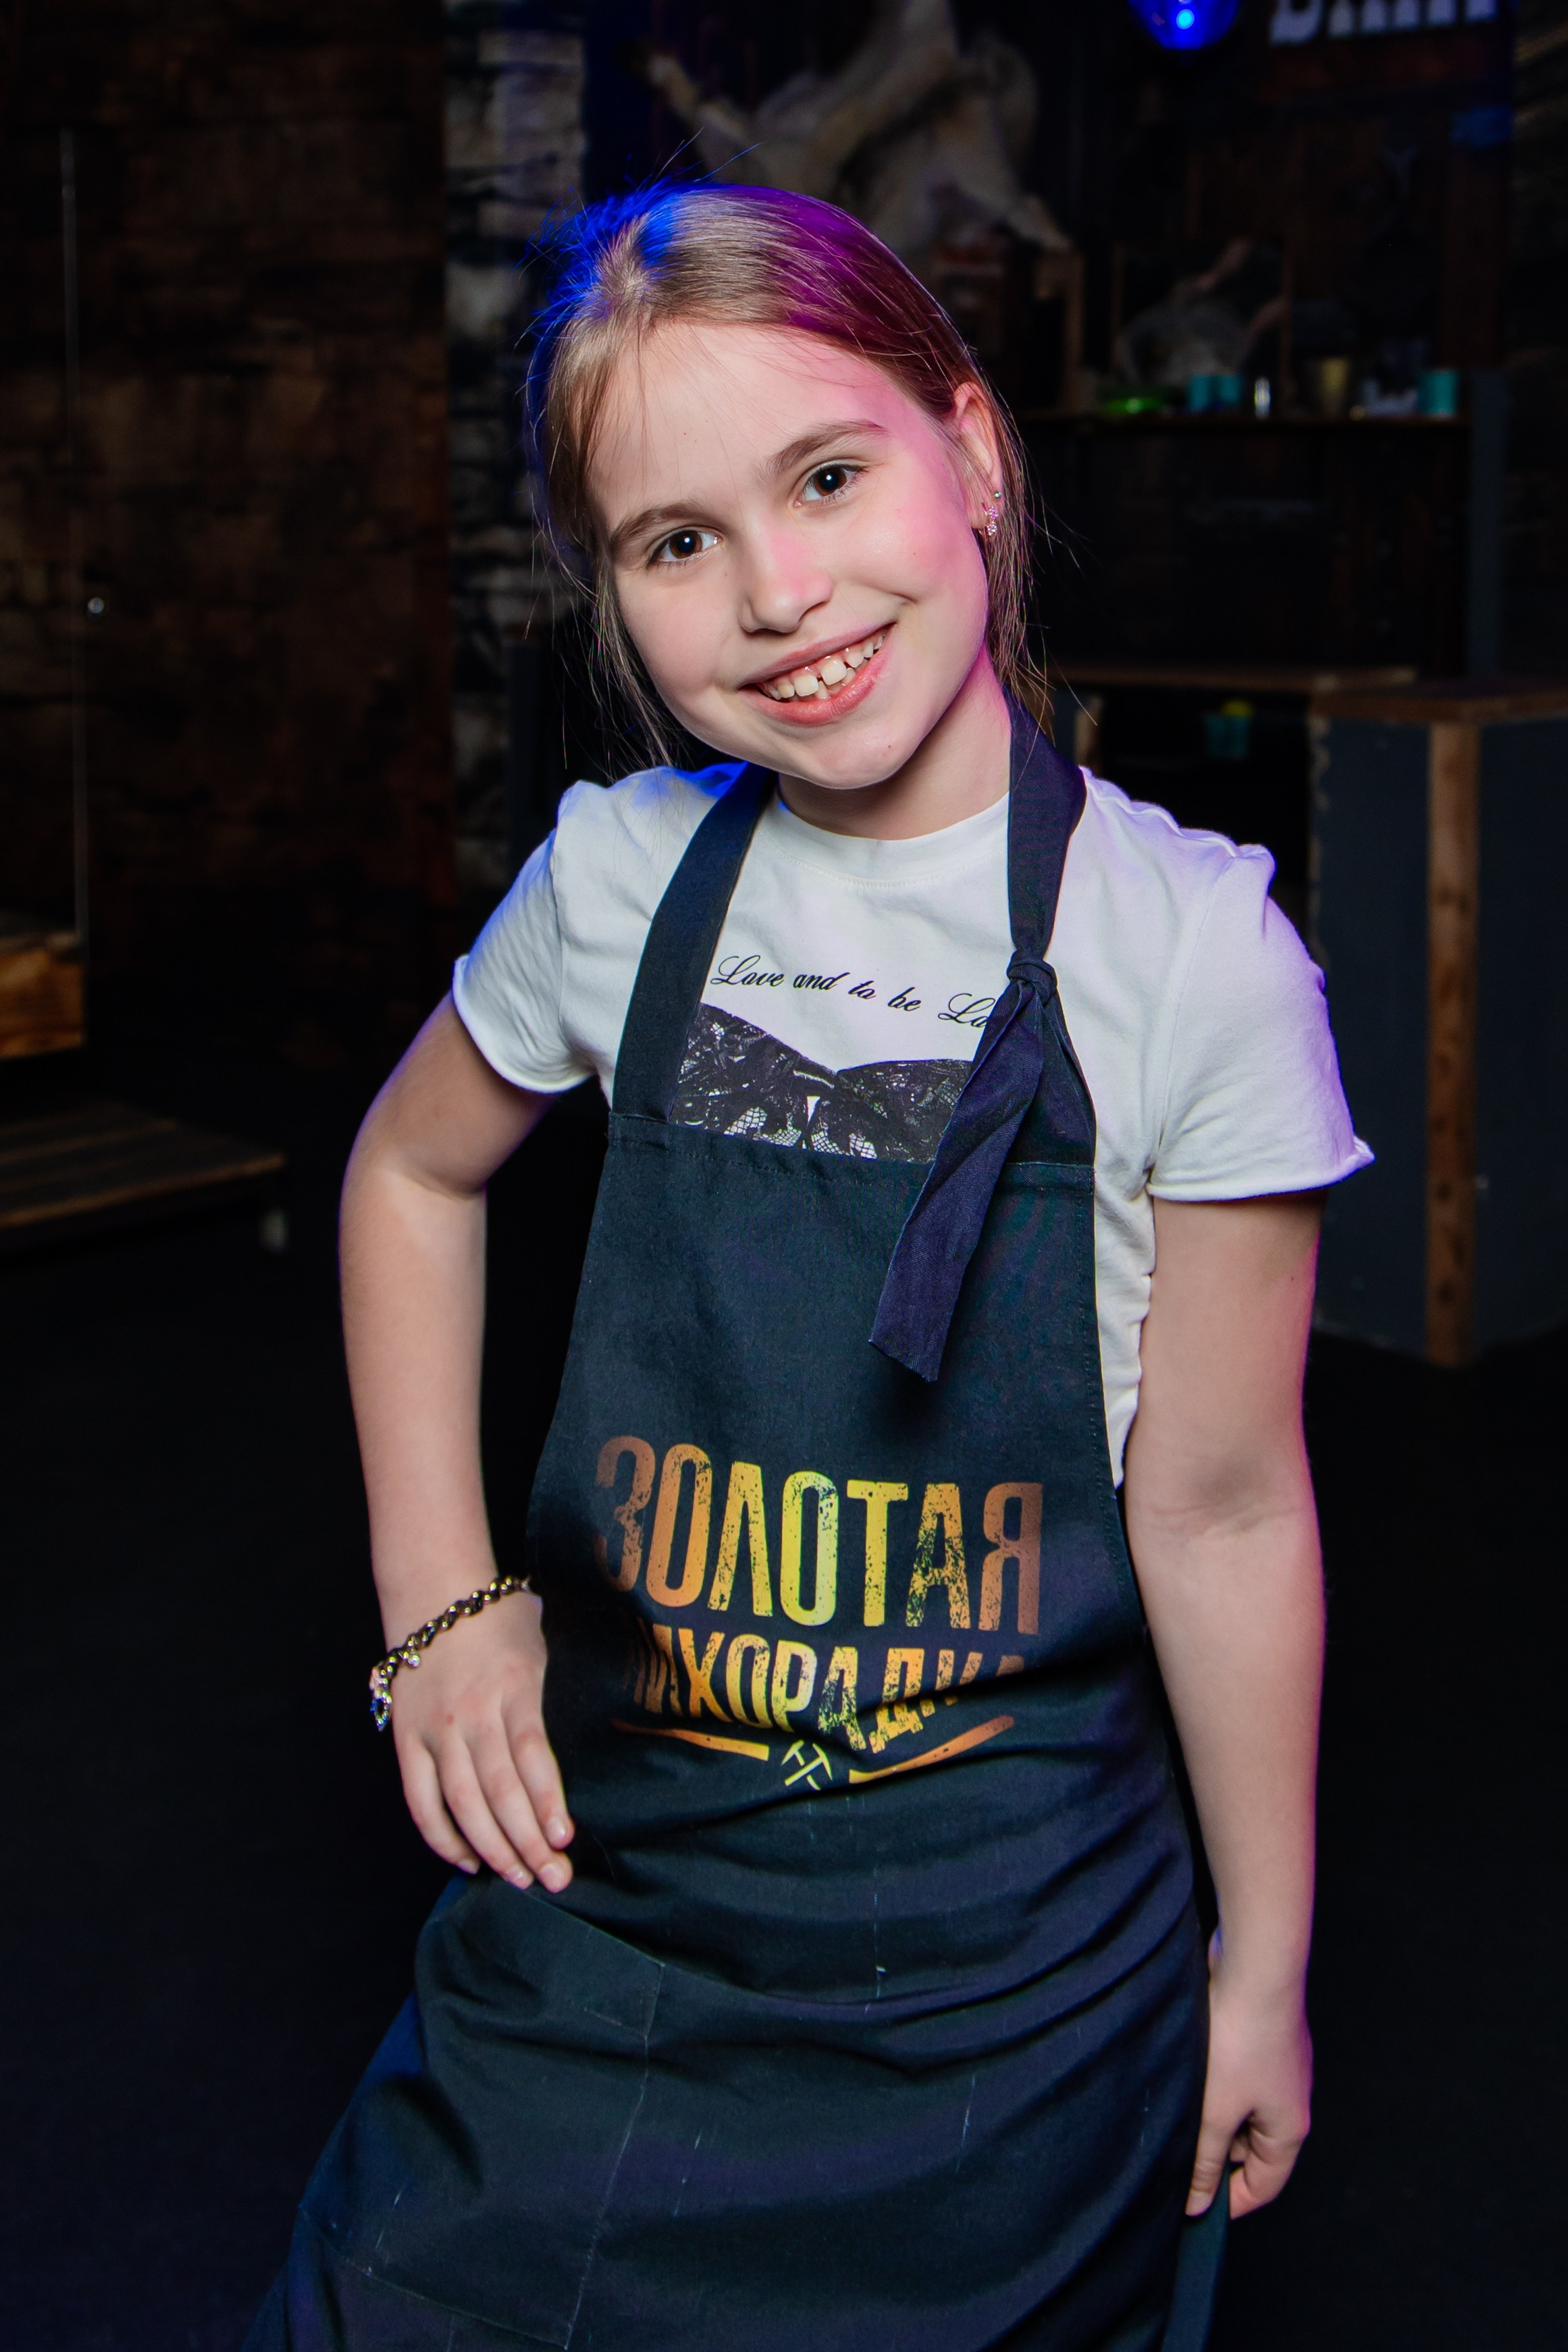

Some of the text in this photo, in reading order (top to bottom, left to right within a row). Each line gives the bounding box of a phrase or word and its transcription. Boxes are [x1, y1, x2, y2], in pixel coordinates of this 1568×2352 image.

[710, 954, 785, 987] Love
[793, 972, 850, 991] and
[847, 980, 877, 999] to
[887, 987, 922, 1012] be
[593, 1434, 1043, 1636] ЗОЛОТАЯ
